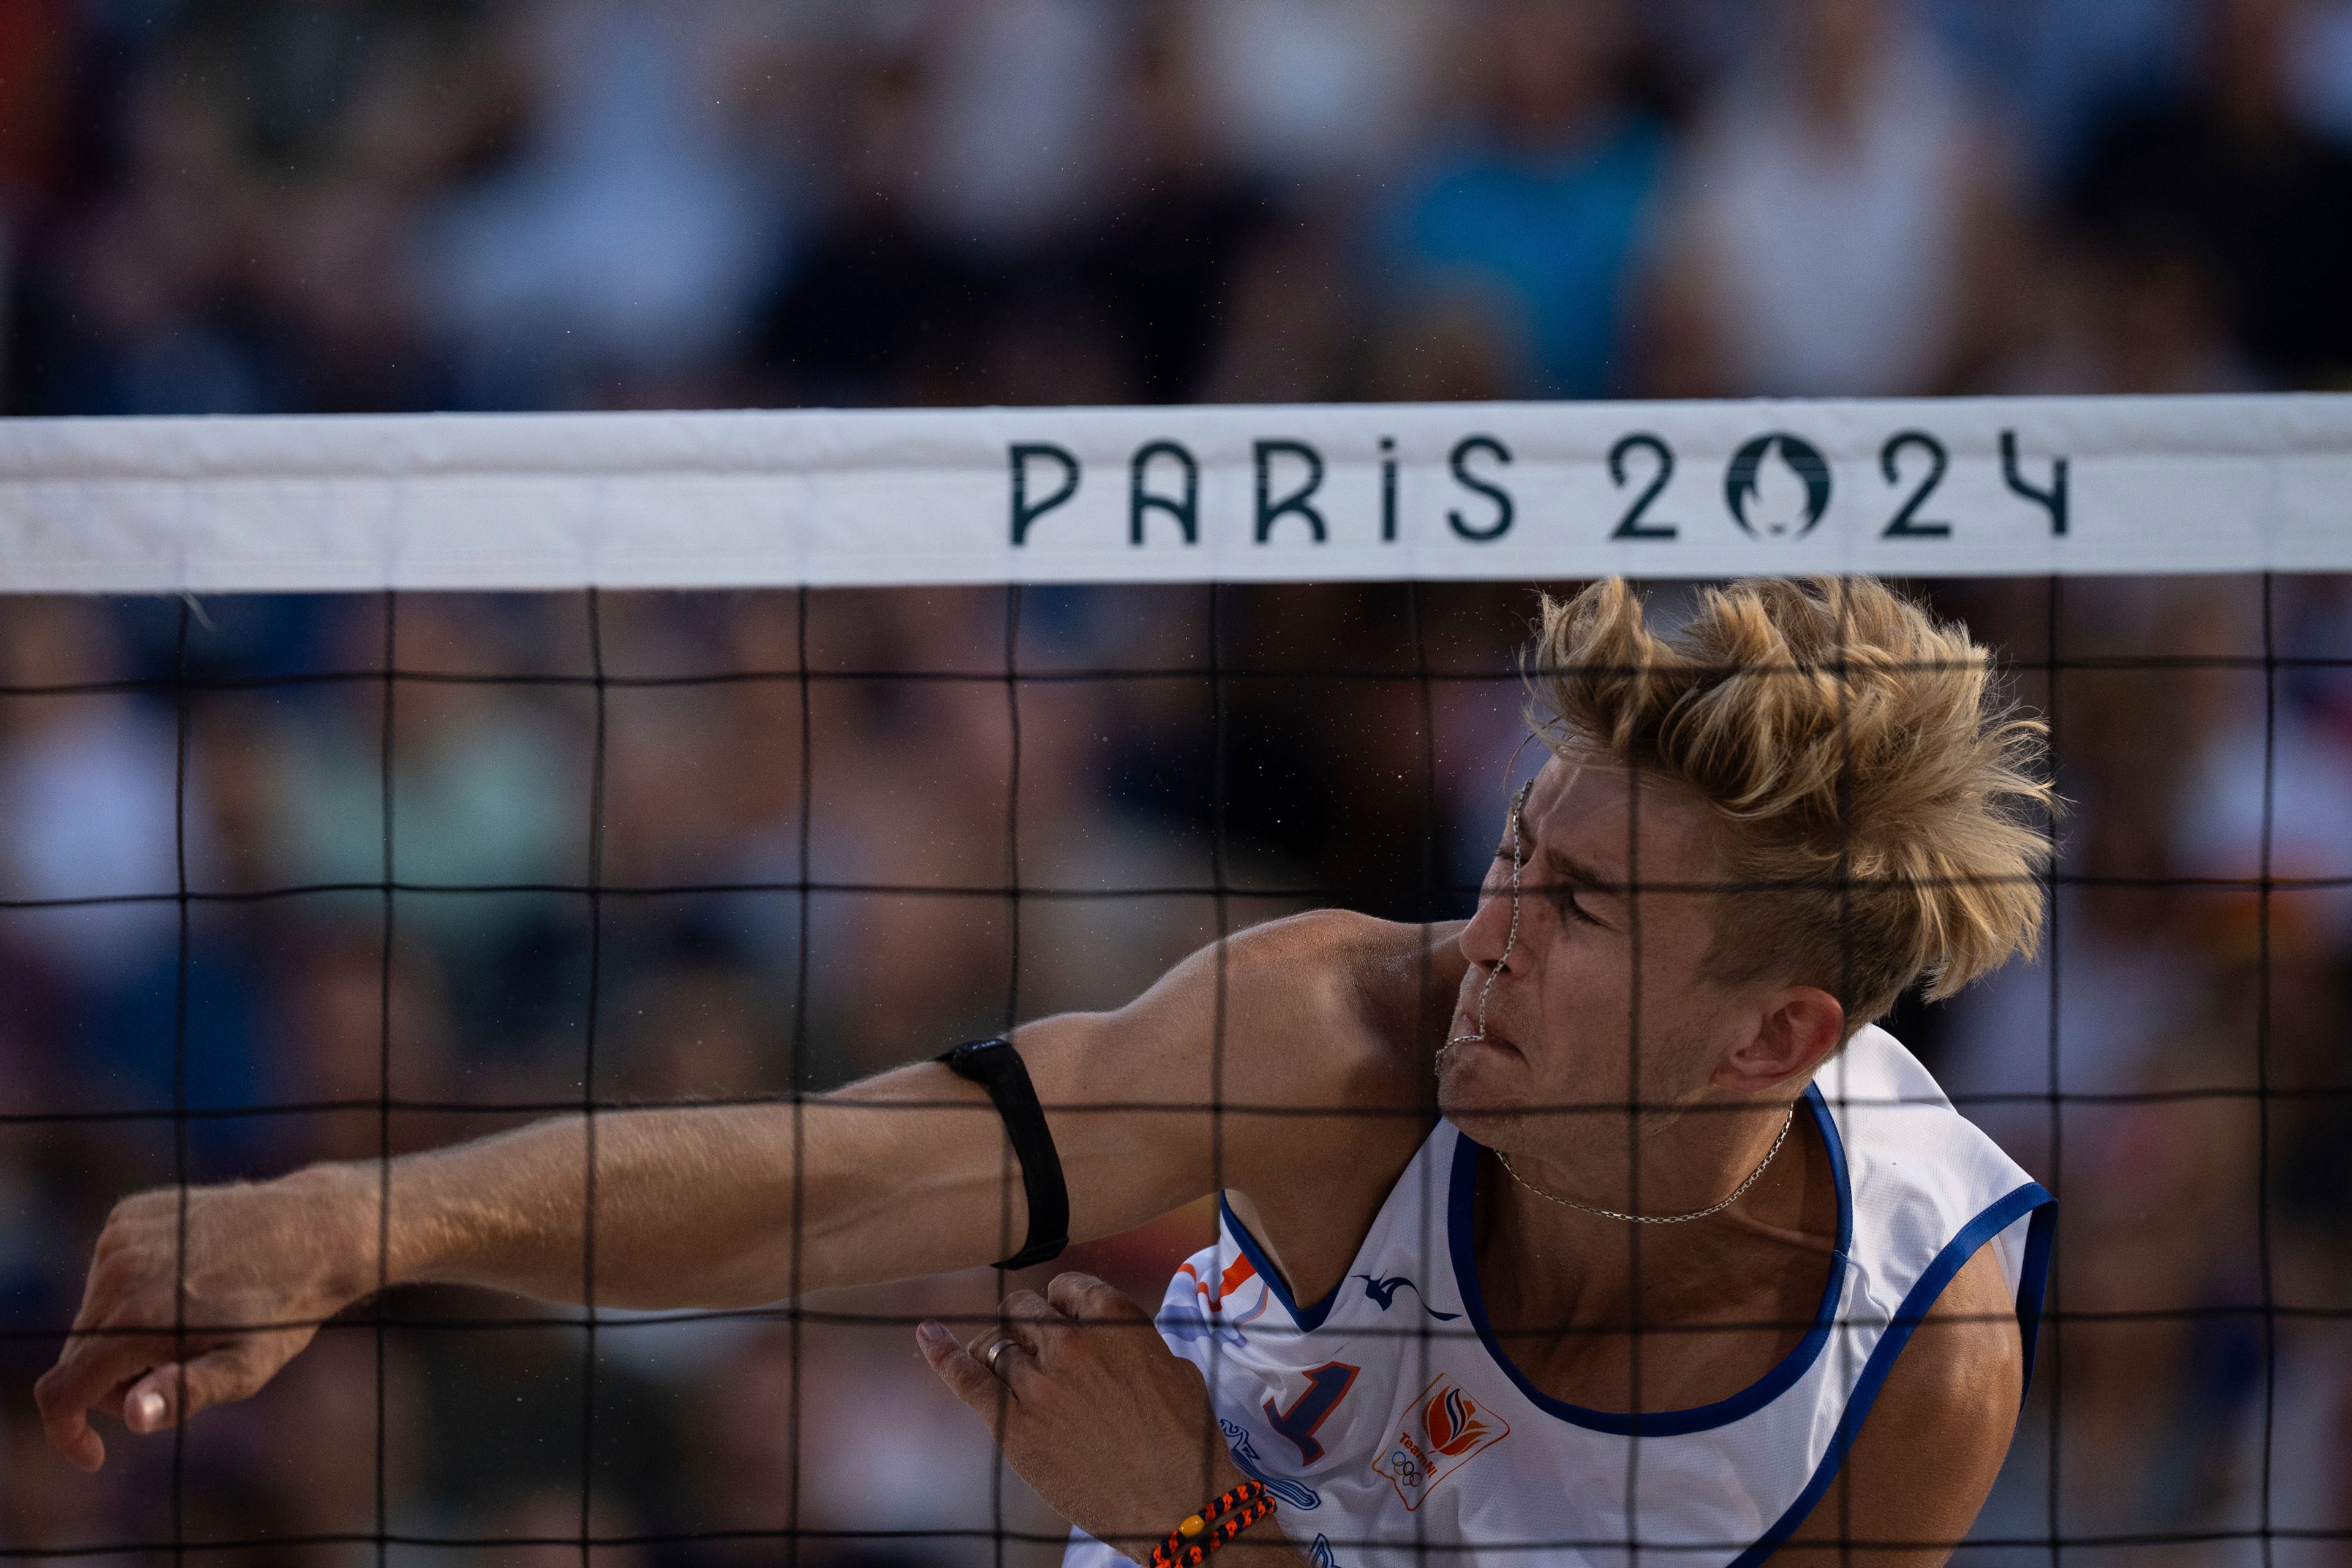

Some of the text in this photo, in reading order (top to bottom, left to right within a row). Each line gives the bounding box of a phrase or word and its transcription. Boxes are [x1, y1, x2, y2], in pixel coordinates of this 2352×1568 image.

[1607, 430, 2070, 539] 2024
[1263, 1361, 1361, 1466] 1
[1398, 1432, 1438, 1479] TeamNL
